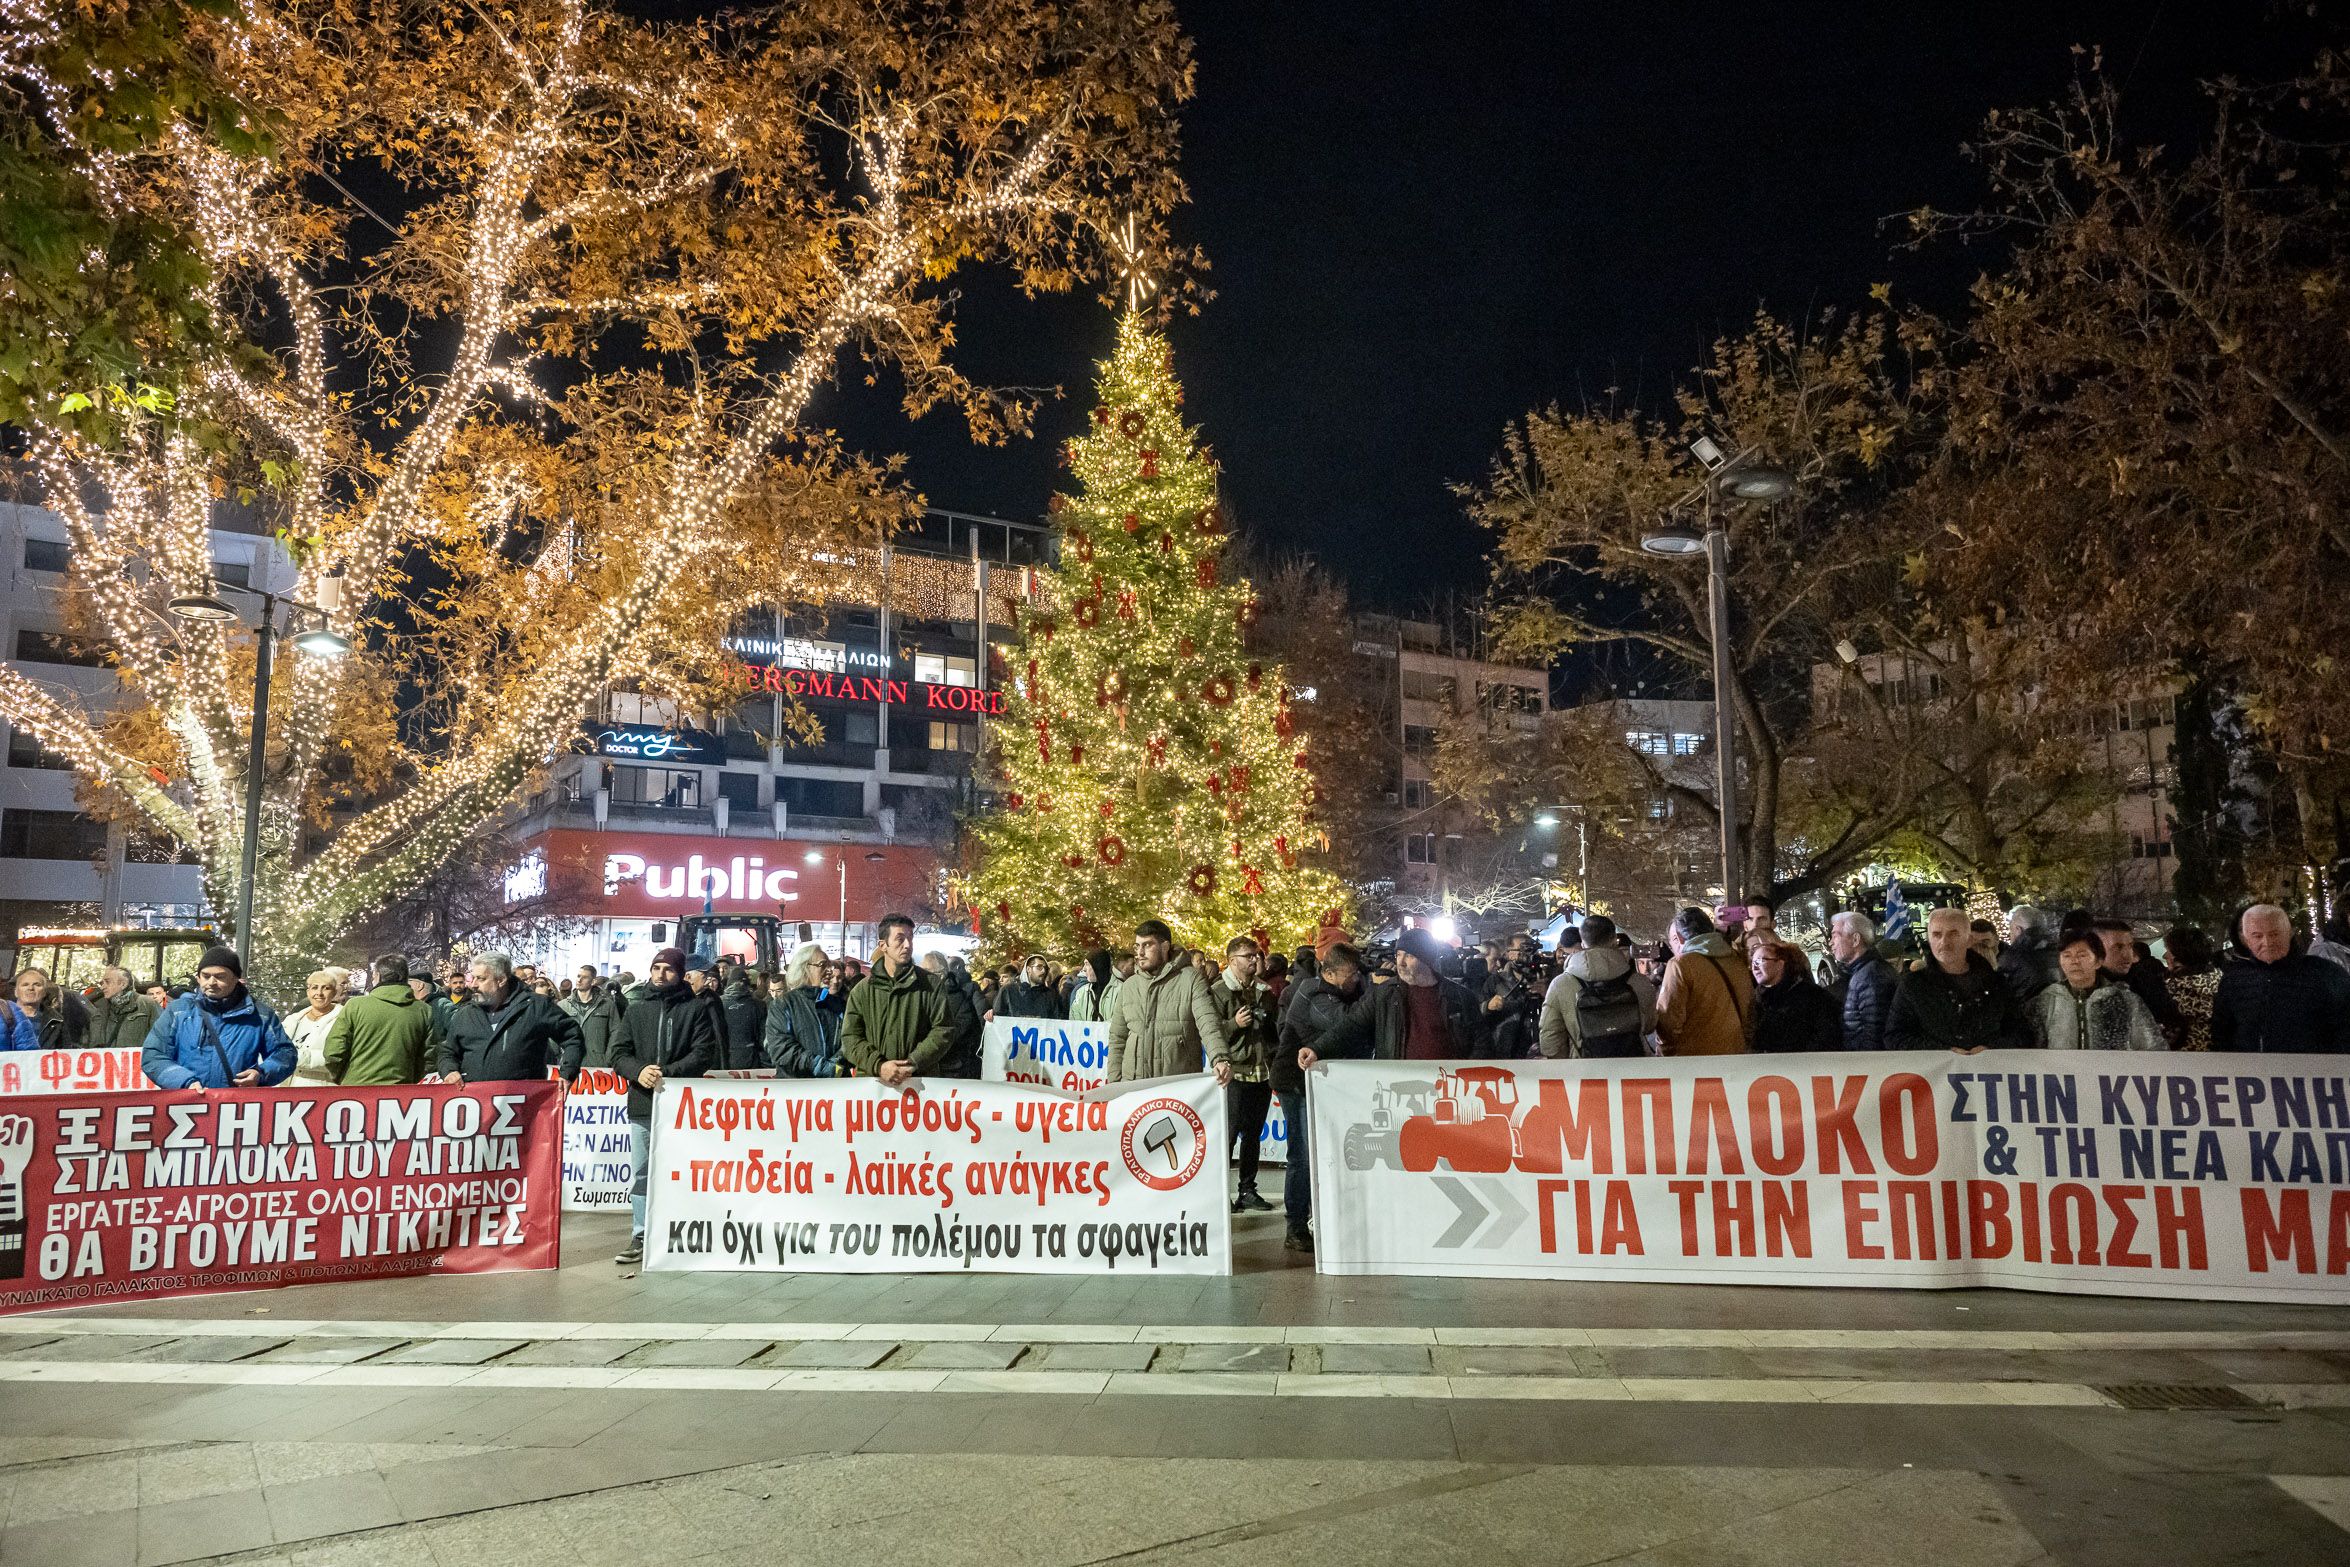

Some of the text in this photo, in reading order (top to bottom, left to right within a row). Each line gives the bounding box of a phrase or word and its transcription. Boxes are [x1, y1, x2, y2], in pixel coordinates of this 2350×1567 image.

[721, 664, 908, 704] ERGMANN
[597, 731, 703, 757] my
[606, 744, 639, 754] DOCTOR
[604, 854, 799, 901] Public
[55, 1095, 526, 1154] ΞΕΣΗΚΩΜΟΣ
[674, 1087, 775, 1142] Λεφτά
[786, 1099, 834, 1143] για
[845, 1087, 981, 1144] μισθούς
[1015, 1094, 1109, 1143] υγεία
[1165, 1100, 1200, 1128] ΚΕΝΤΡΟ
[1538, 1072, 1939, 1176] ΜΠΛΟΚΟ
[1947, 1073, 2350, 1128] ΣΤΗΝ ΚΥΒΕΡΝΗ
[53, 1134, 521, 1194] ΣΤΑ ΜΠΛΟΚΑ ΤΟΥ ΑΓΩΝΑ
[690, 1149, 814, 1194] παιδεία
[845, 1151, 953, 1208] λαϊκές
[965, 1151, 1111, 1206] ανάγκες
[1983, 1125, 2019, 1176] &
[2035, 1127, 2099, 1178] ΤΗ
[2118, 1128, 2228, 1181] ΝΕΑ
[46, 1176, 528, 1233] ΕΡΓΑΤΕΣ-ΑΓΡΟΤΕΣ ΟΛΟΙ ΕΝΩΜΕΝΟΙ
[1537, 1179, 1645, 1256] ΓΙΑ
[1668, 1180, 1812, 1258] ΤΗΝ
[1841, 1180, 2209, 1270] ΕΠΙΒΙΩΣΗ
[40, 1203, 527, 1280] ΘΑ ΒΓΟΥΜΕ ΝΙΚΗΤΕΣ
[667, 1210, 1209, 1268] και όχι για του πολέμου τα σφαγεία
[95, 1275, 187, 1296] ΓΑΛΑΚΤΟΣ
[190, 1269, 281, 1287] ΤΡΟΦΙΜΩΝ
[285, 1268, 296, 1279] &
[300, 1263, 359, 1278] ΠΟΤΩΝ
[380, 1254, 445, 1272] ΛΑΡΙΣΑΣ
